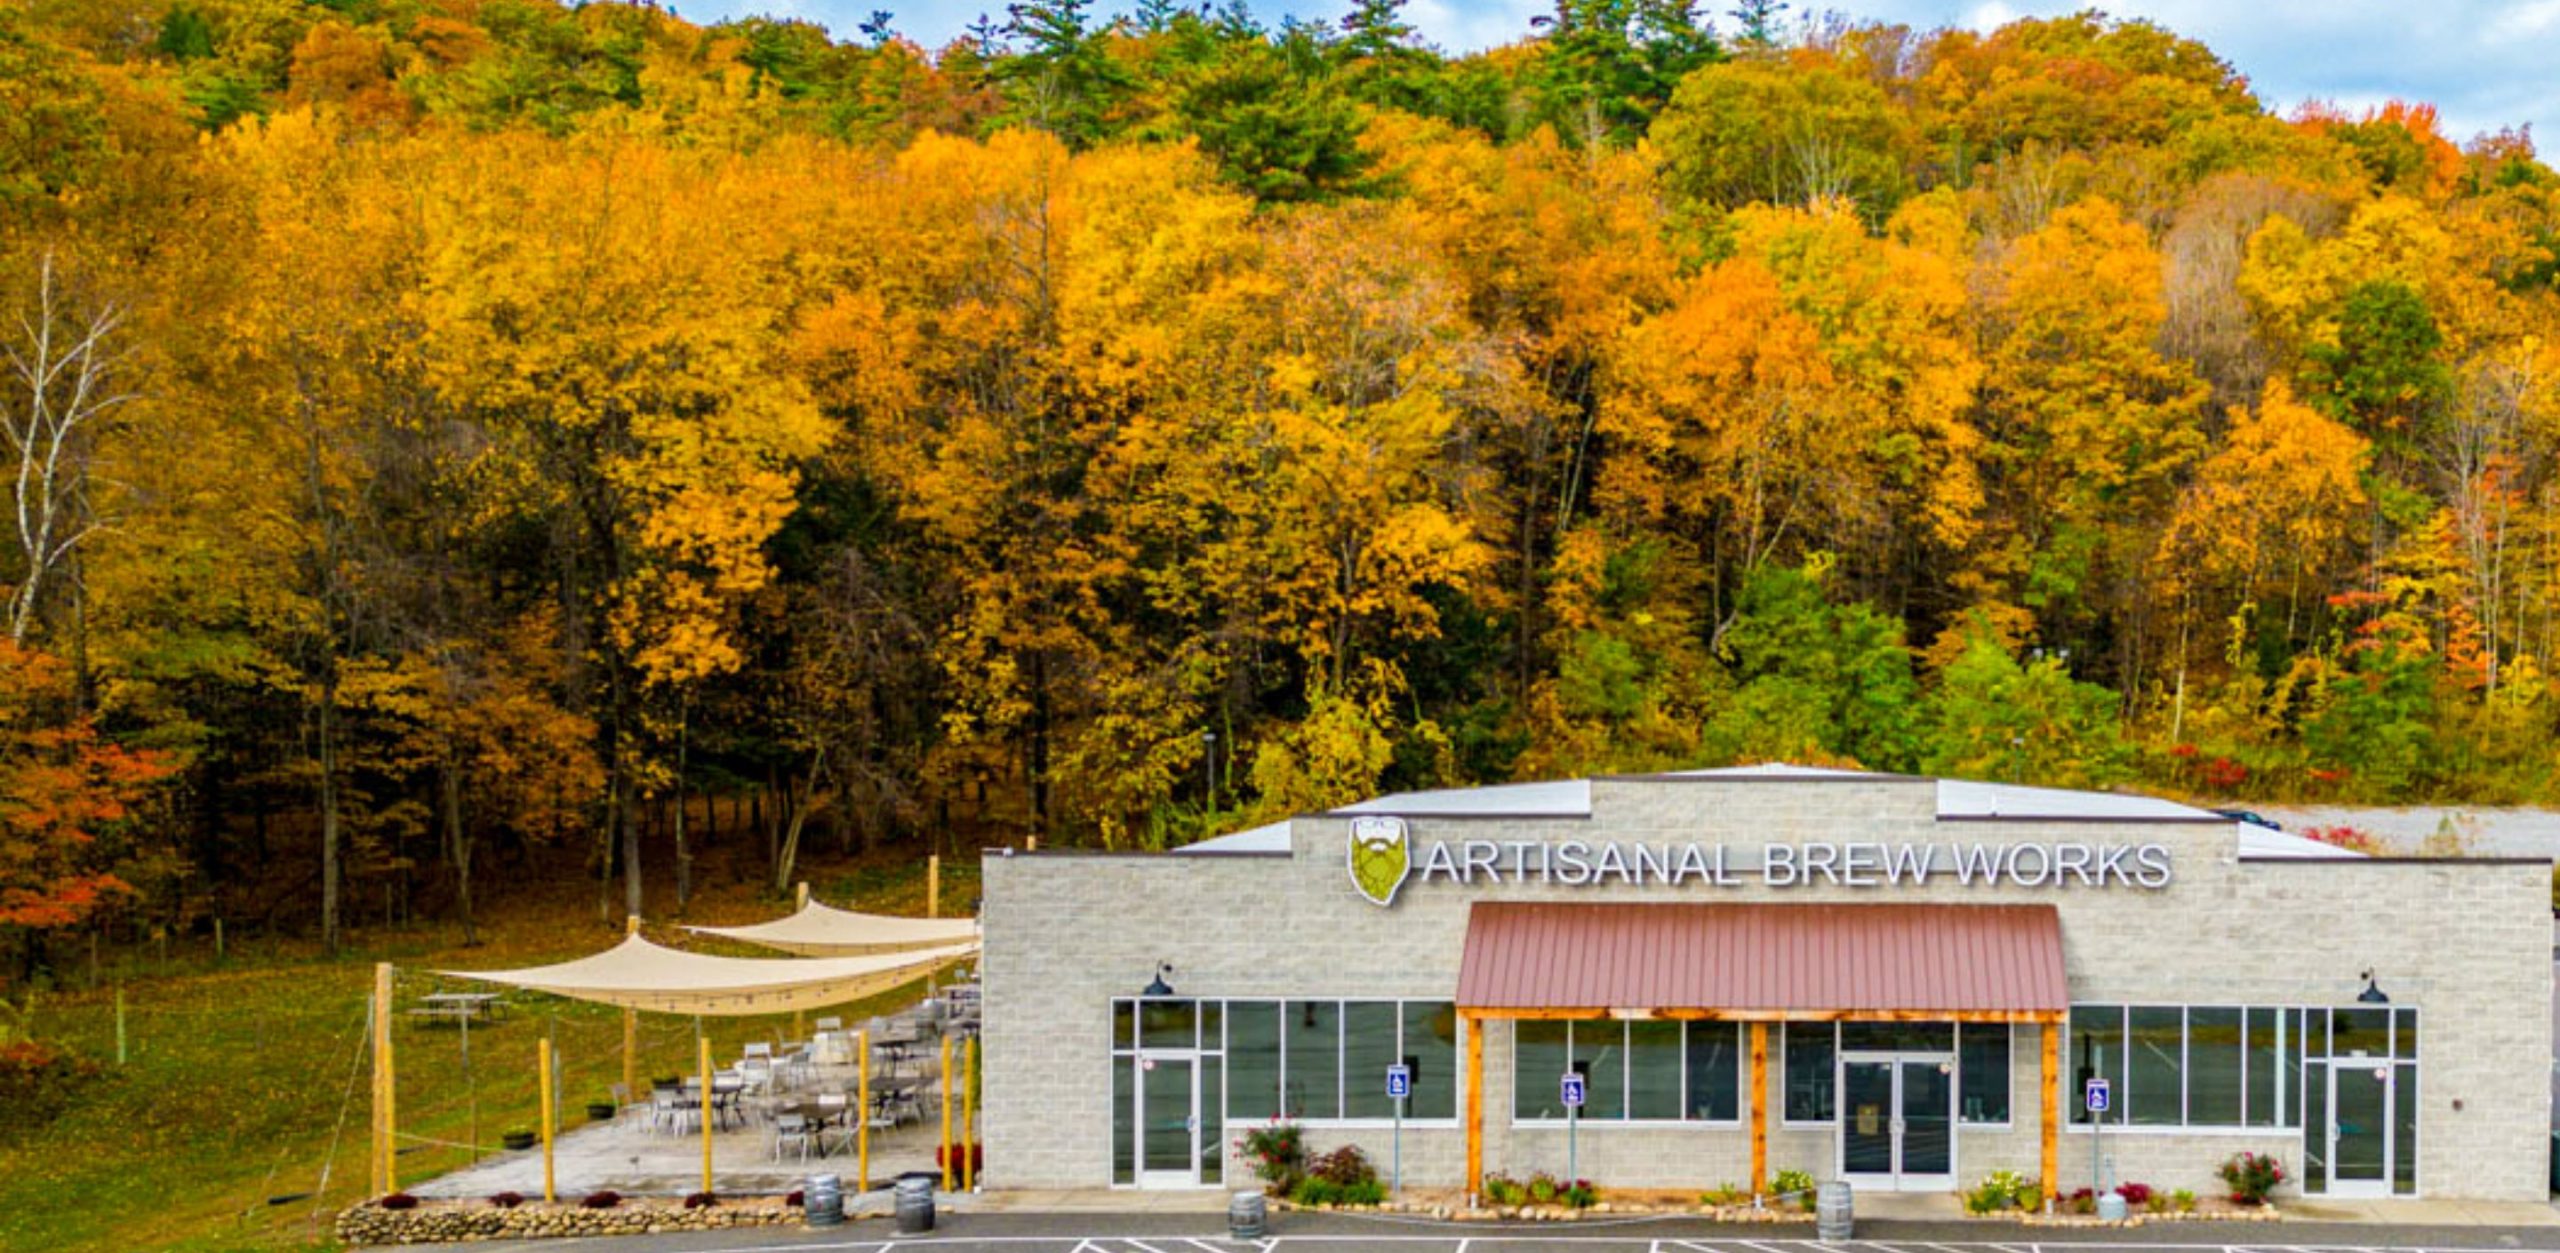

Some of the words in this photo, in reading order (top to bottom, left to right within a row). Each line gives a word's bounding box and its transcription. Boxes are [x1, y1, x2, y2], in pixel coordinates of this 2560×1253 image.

[1421, 840, 1742, 884] ARTISANAL
[1763, 843, 1935, 886] BREW
[1951, 843, 2170, 887] WORKS
